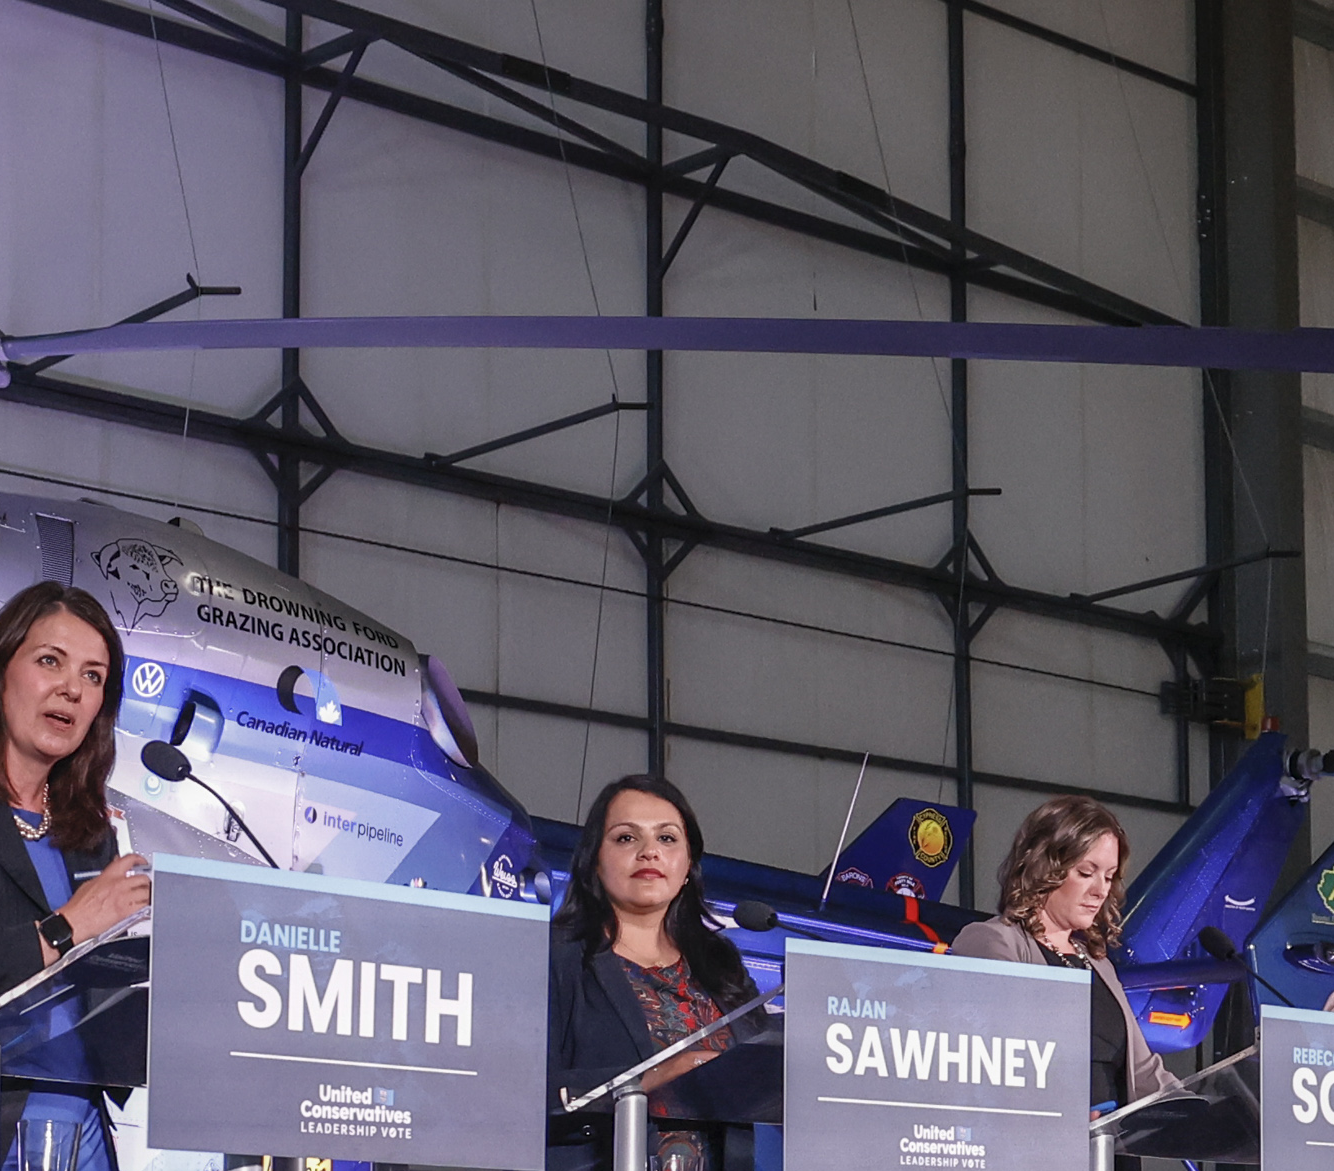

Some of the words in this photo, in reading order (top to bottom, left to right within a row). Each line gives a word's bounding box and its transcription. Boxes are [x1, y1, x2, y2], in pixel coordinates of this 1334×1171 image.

[242, 587, 346, 632] DROWNING
[352, 620, 399, 649] FORD
[197, 604, 284, 641] GRAZING
[288, 628, 406, 677] ASSOCIATION
[236, 710, 308, 743] Canadian
[309, 729, 364, 757] Natural
[240, 919, 341, 954] DANIELLE
[237, 948, 473, 1047] SMITH
[827, 996, 886, 1020] RAJAN
[826, 1022, 1056, 1089] SAWHNEY
[319, 1084, 372, 1105] United
[300, 1100, 411, 1124] Conservatives
[300, 1121, 377, 1138] LEADERSHIP
[381, 1123, 412, 1139] VOTE
[913, 1124, 955, 1141] United
[900, 1138, 985, 1157] Conservatives
[900, 1155, 959, 1168] LEADERSHIP
[961, 1158, 986, 1169] VOTE
